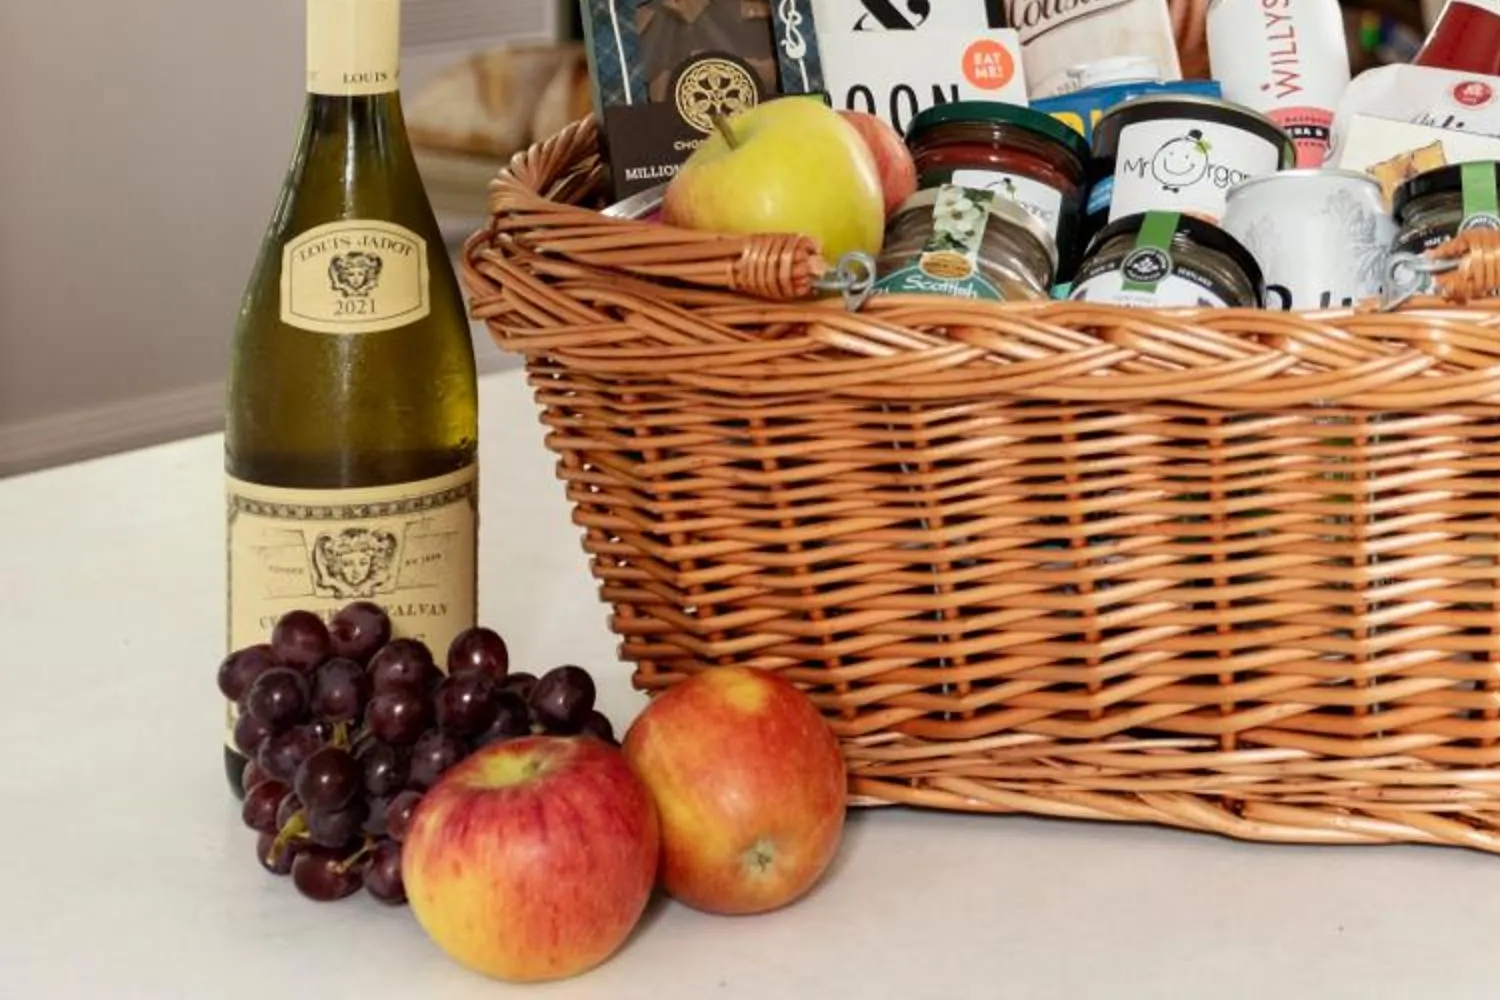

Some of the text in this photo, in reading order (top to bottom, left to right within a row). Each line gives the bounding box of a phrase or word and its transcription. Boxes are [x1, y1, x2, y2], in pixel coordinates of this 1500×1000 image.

[973, 51, 1002, 66] EAT
[342, 71, 388, 84] LOUIS
[673, 139, 703, 151] CHO
[1123, 137, 1251, 189] Mr Orga
[300, 235, 413, 261] LOUIS JADOT
[333, 301, 377, 316] 2021
